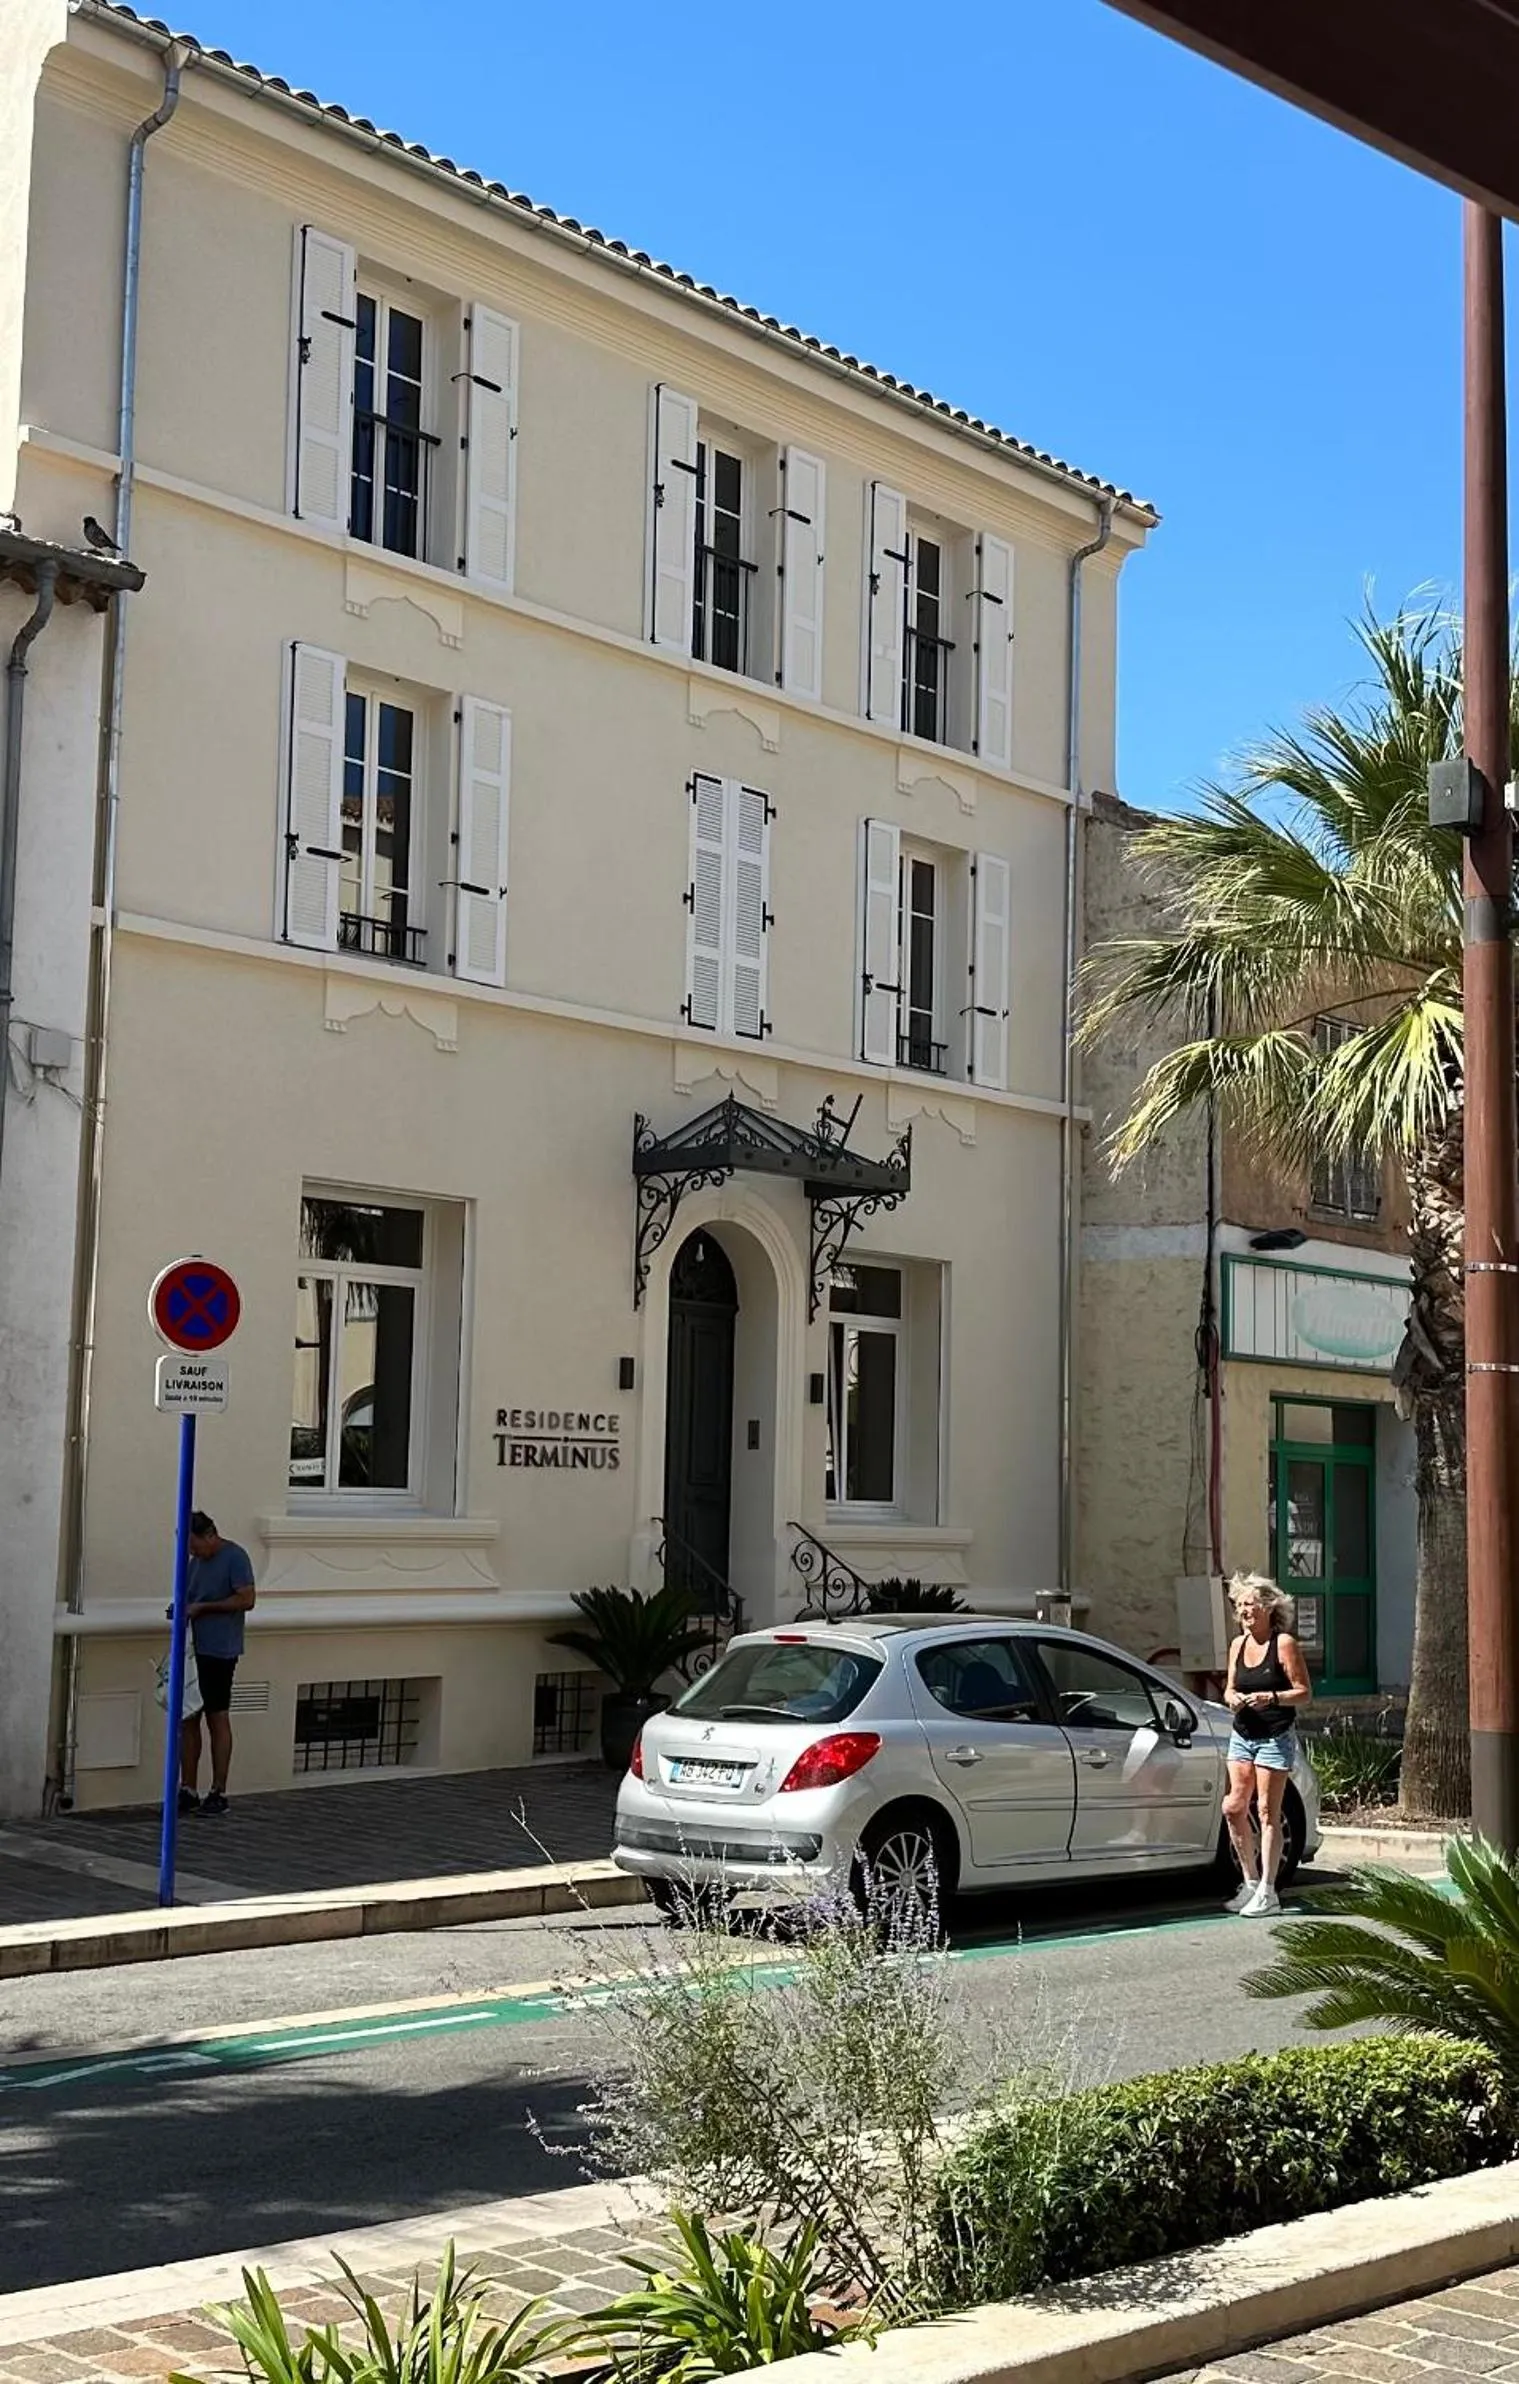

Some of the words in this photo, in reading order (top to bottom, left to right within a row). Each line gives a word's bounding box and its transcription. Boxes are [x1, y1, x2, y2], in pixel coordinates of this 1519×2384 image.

[179, 1366, 207, 1377] SAUF
[165, 1379, 223, 1391] LIVRAISON
[496, 1408, 620, 1433] RESIDENCE
